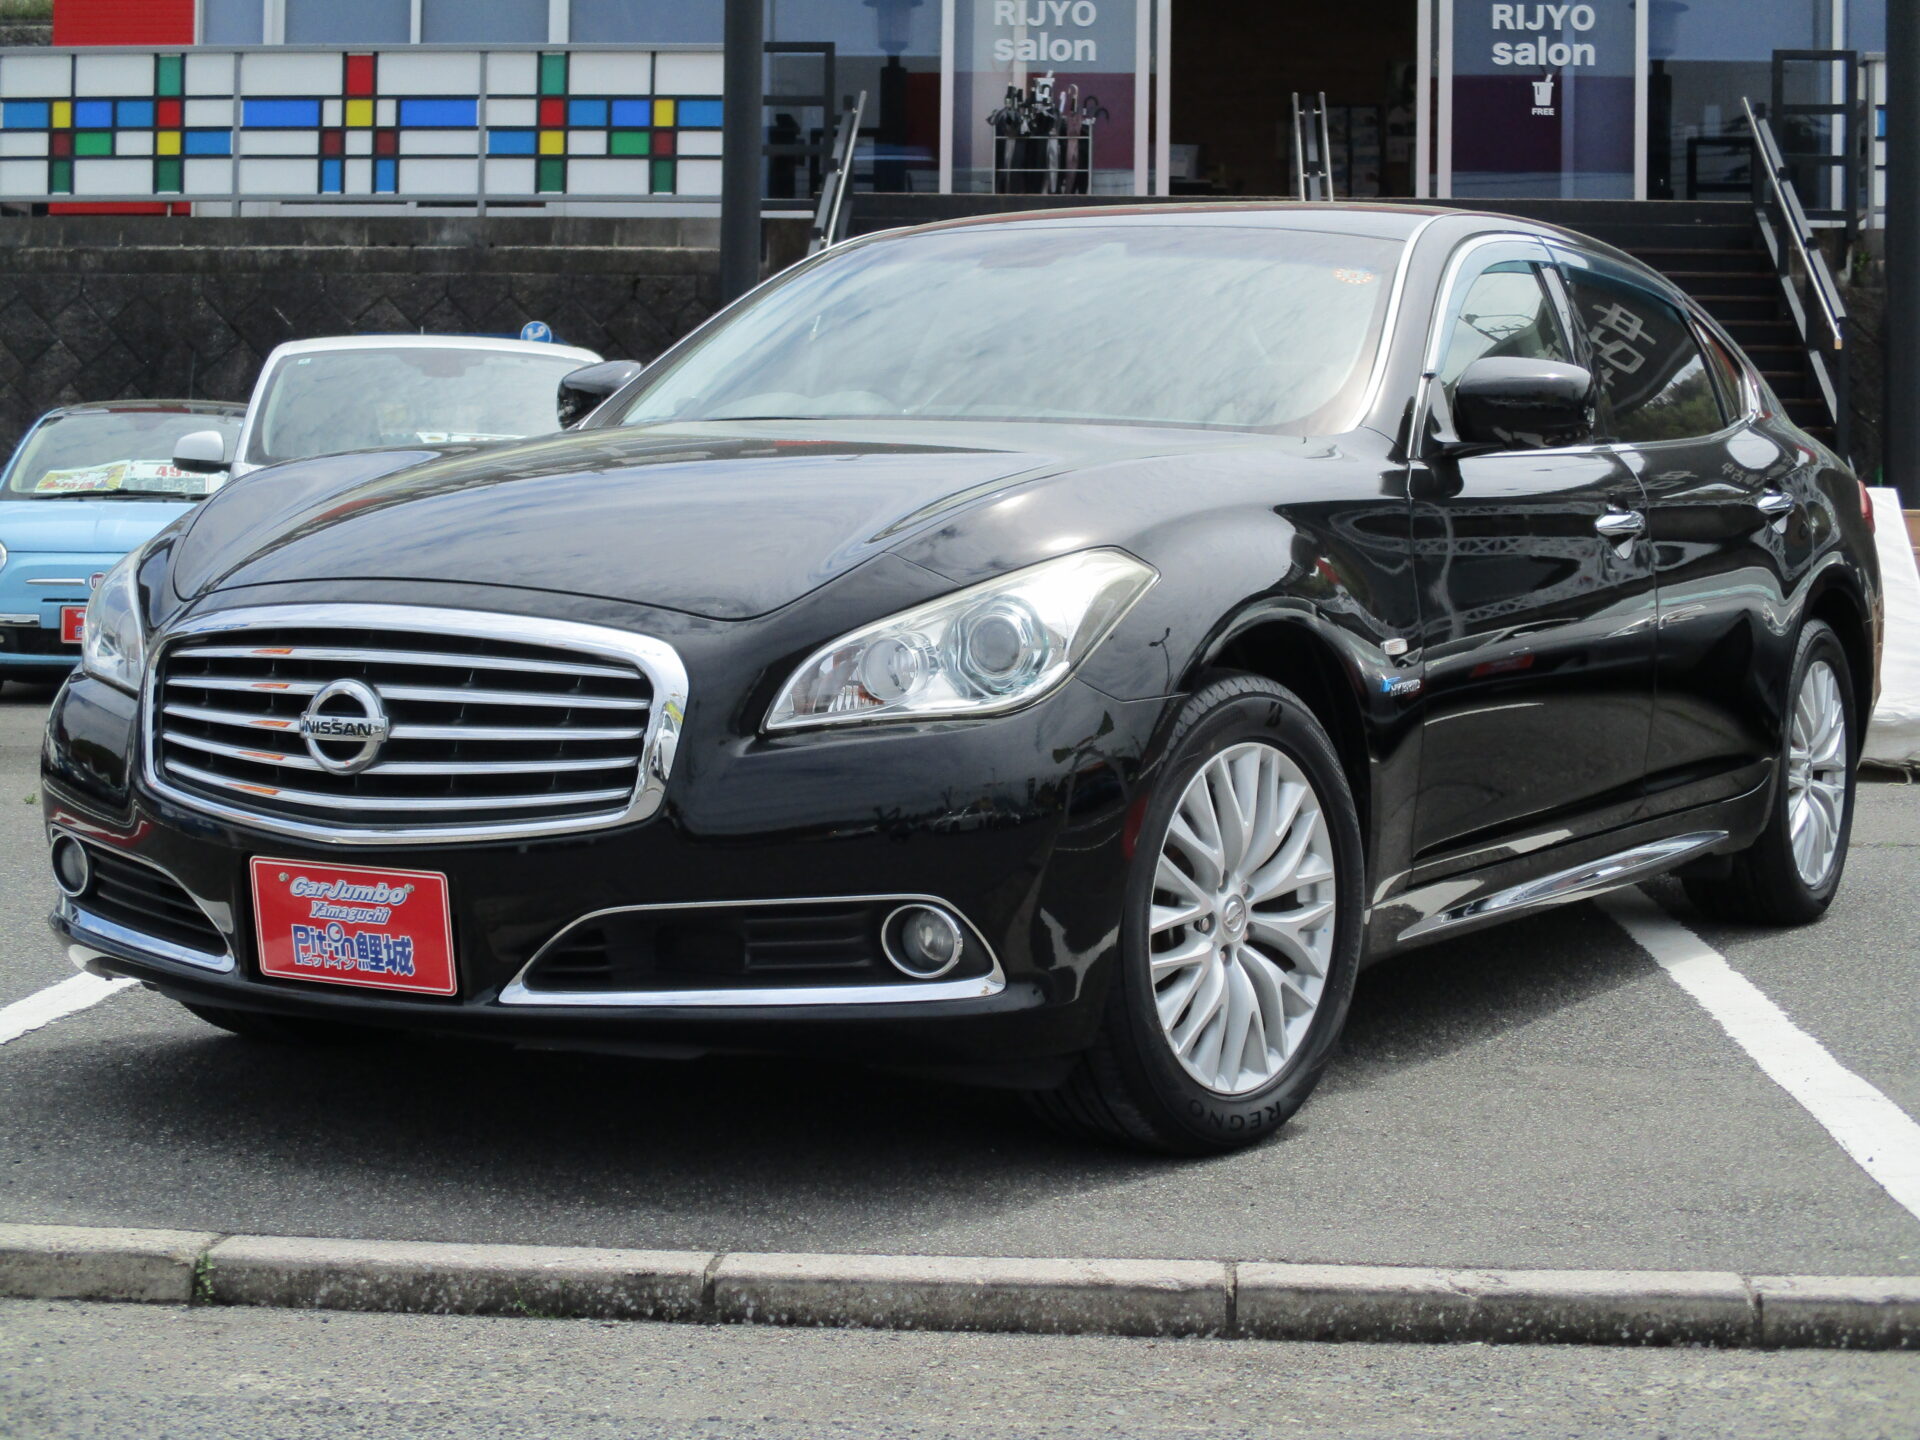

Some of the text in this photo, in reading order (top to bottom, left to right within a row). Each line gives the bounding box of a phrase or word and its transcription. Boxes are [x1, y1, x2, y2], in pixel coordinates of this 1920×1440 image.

[994, 0, 1097, 27] RIJYO
[1492, 4, 1596, 31] RIJYO
[993, 31, 1097, 62] salon
[1491, 36, 1596, 66] salon
[1531, 107, 1555, 116] FREE
[305, 720, 372, 737] NISSAN
[309, 900, 391, 925] Yamaguchi
[1188, 1099, 1282, 1132] REGNO
